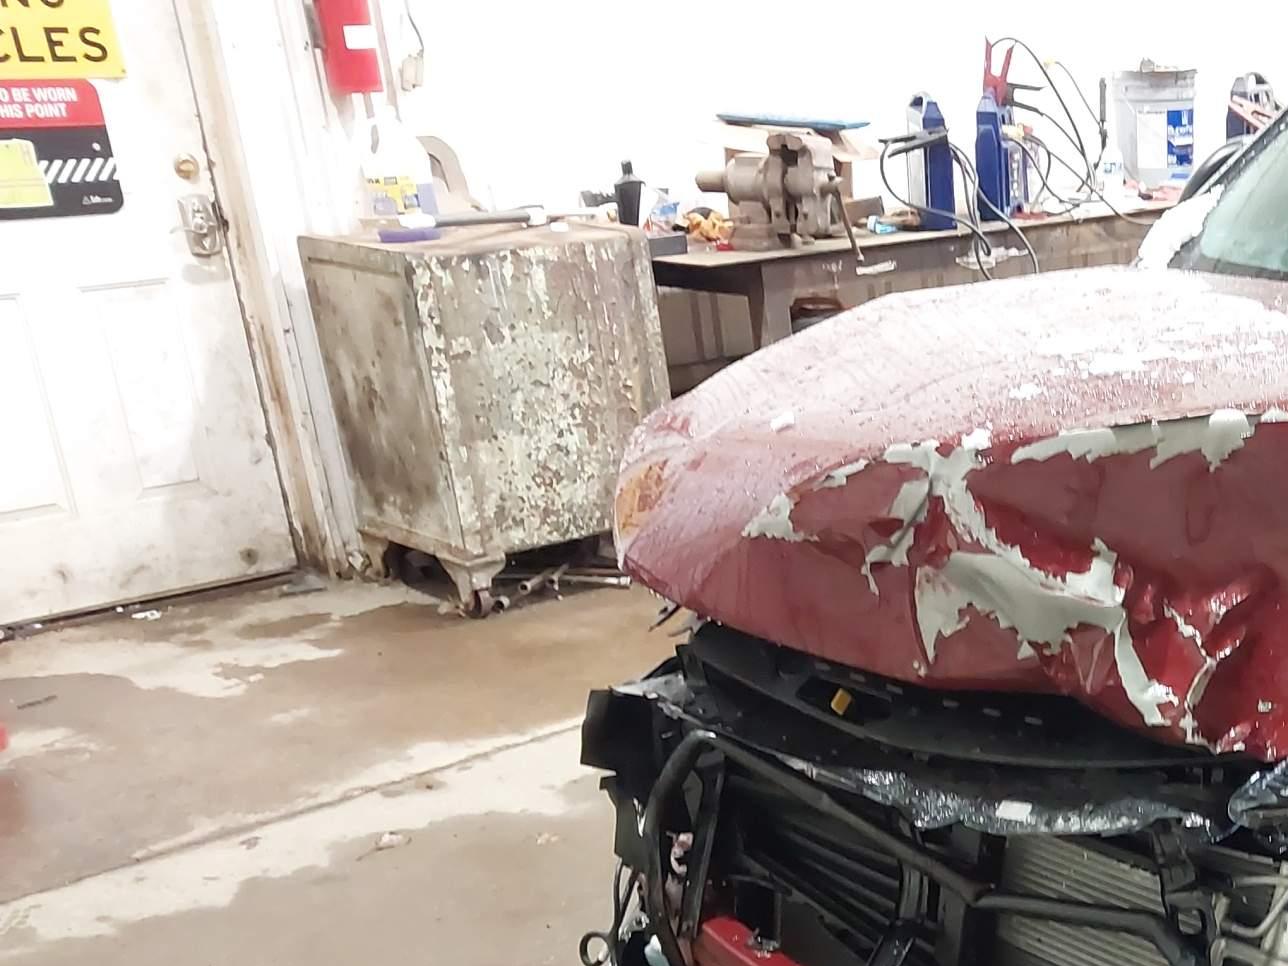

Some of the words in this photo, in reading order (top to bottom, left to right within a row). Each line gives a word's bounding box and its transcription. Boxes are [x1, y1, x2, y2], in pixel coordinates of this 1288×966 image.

[11, 87, 32, 102] BE
[31, 86, 78, 102] WORN
[0, 103, 24, 118] HIS
[25, 103, 68, 118] POINT
